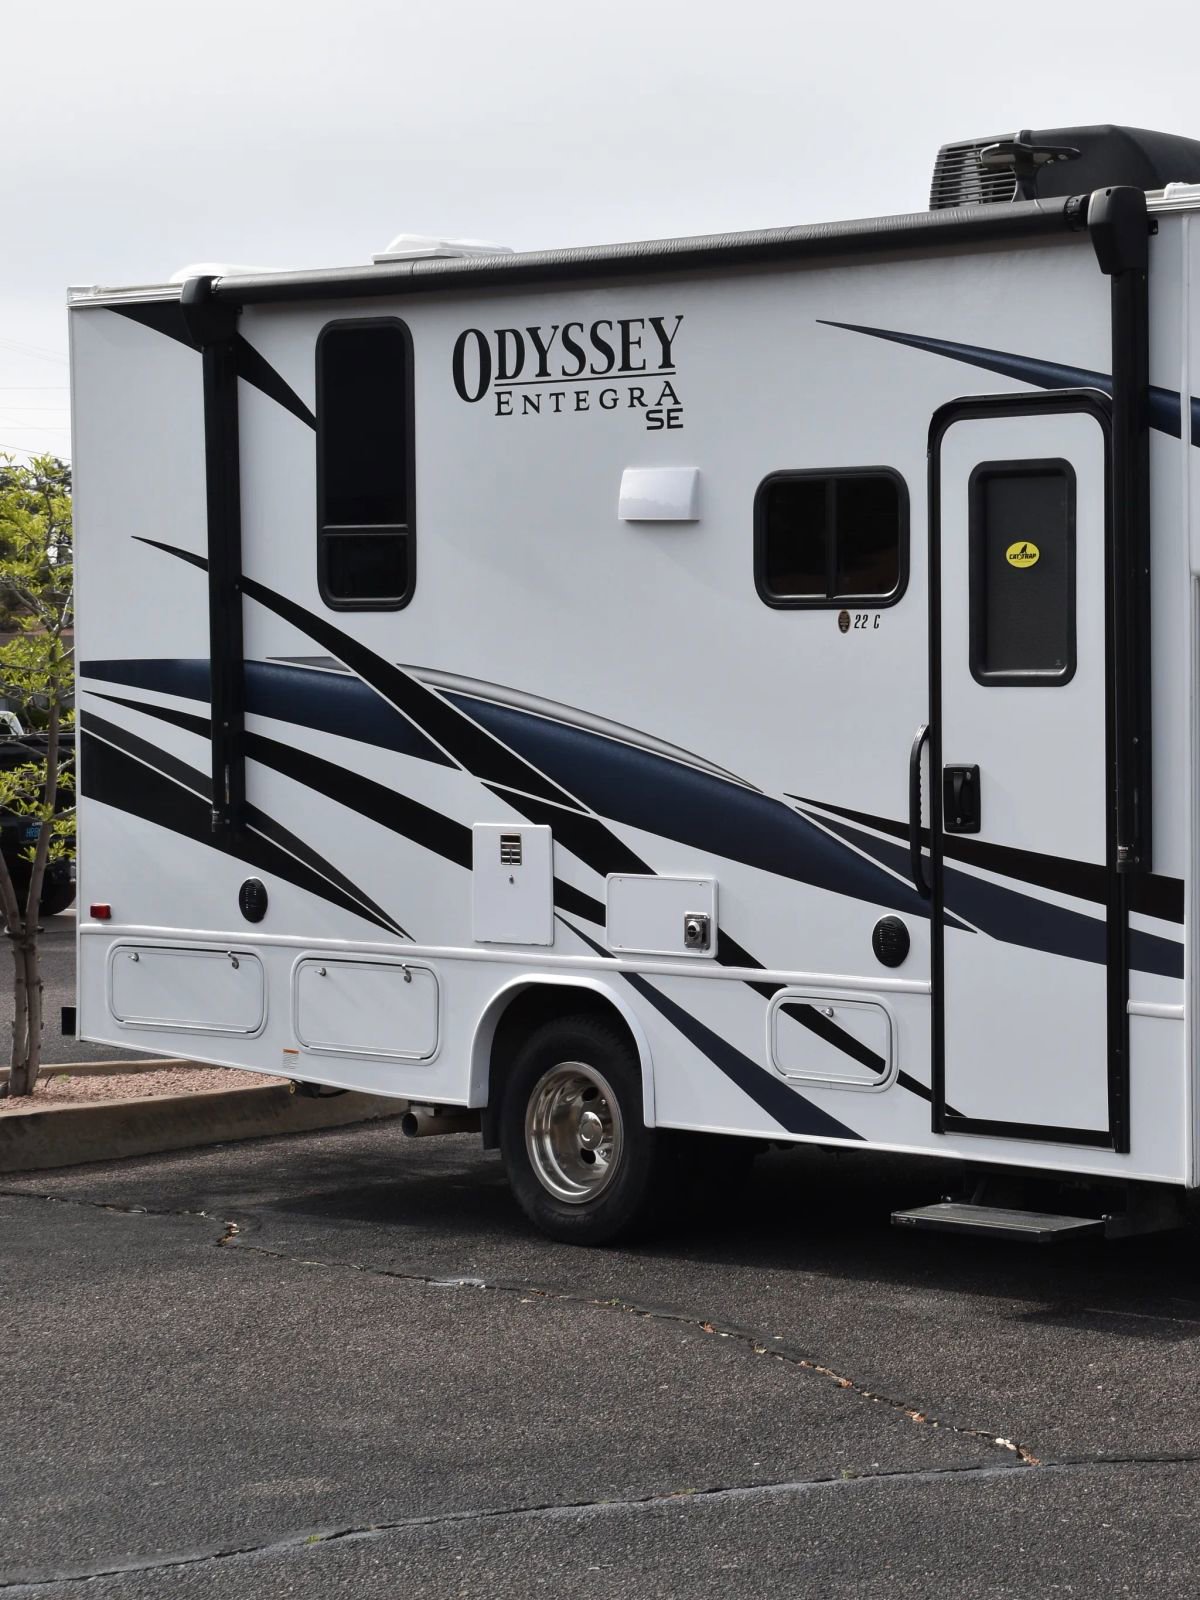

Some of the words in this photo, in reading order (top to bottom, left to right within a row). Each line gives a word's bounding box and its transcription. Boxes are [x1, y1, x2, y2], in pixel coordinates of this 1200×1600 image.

[452, 315, 684, 403] ODYSSEY
[494, 381, 682, 416] ENTEGRA
[645, 407, 684, 430] SE
[854, 614, 869, 629] 22
[873, 614, 881, 629] C
